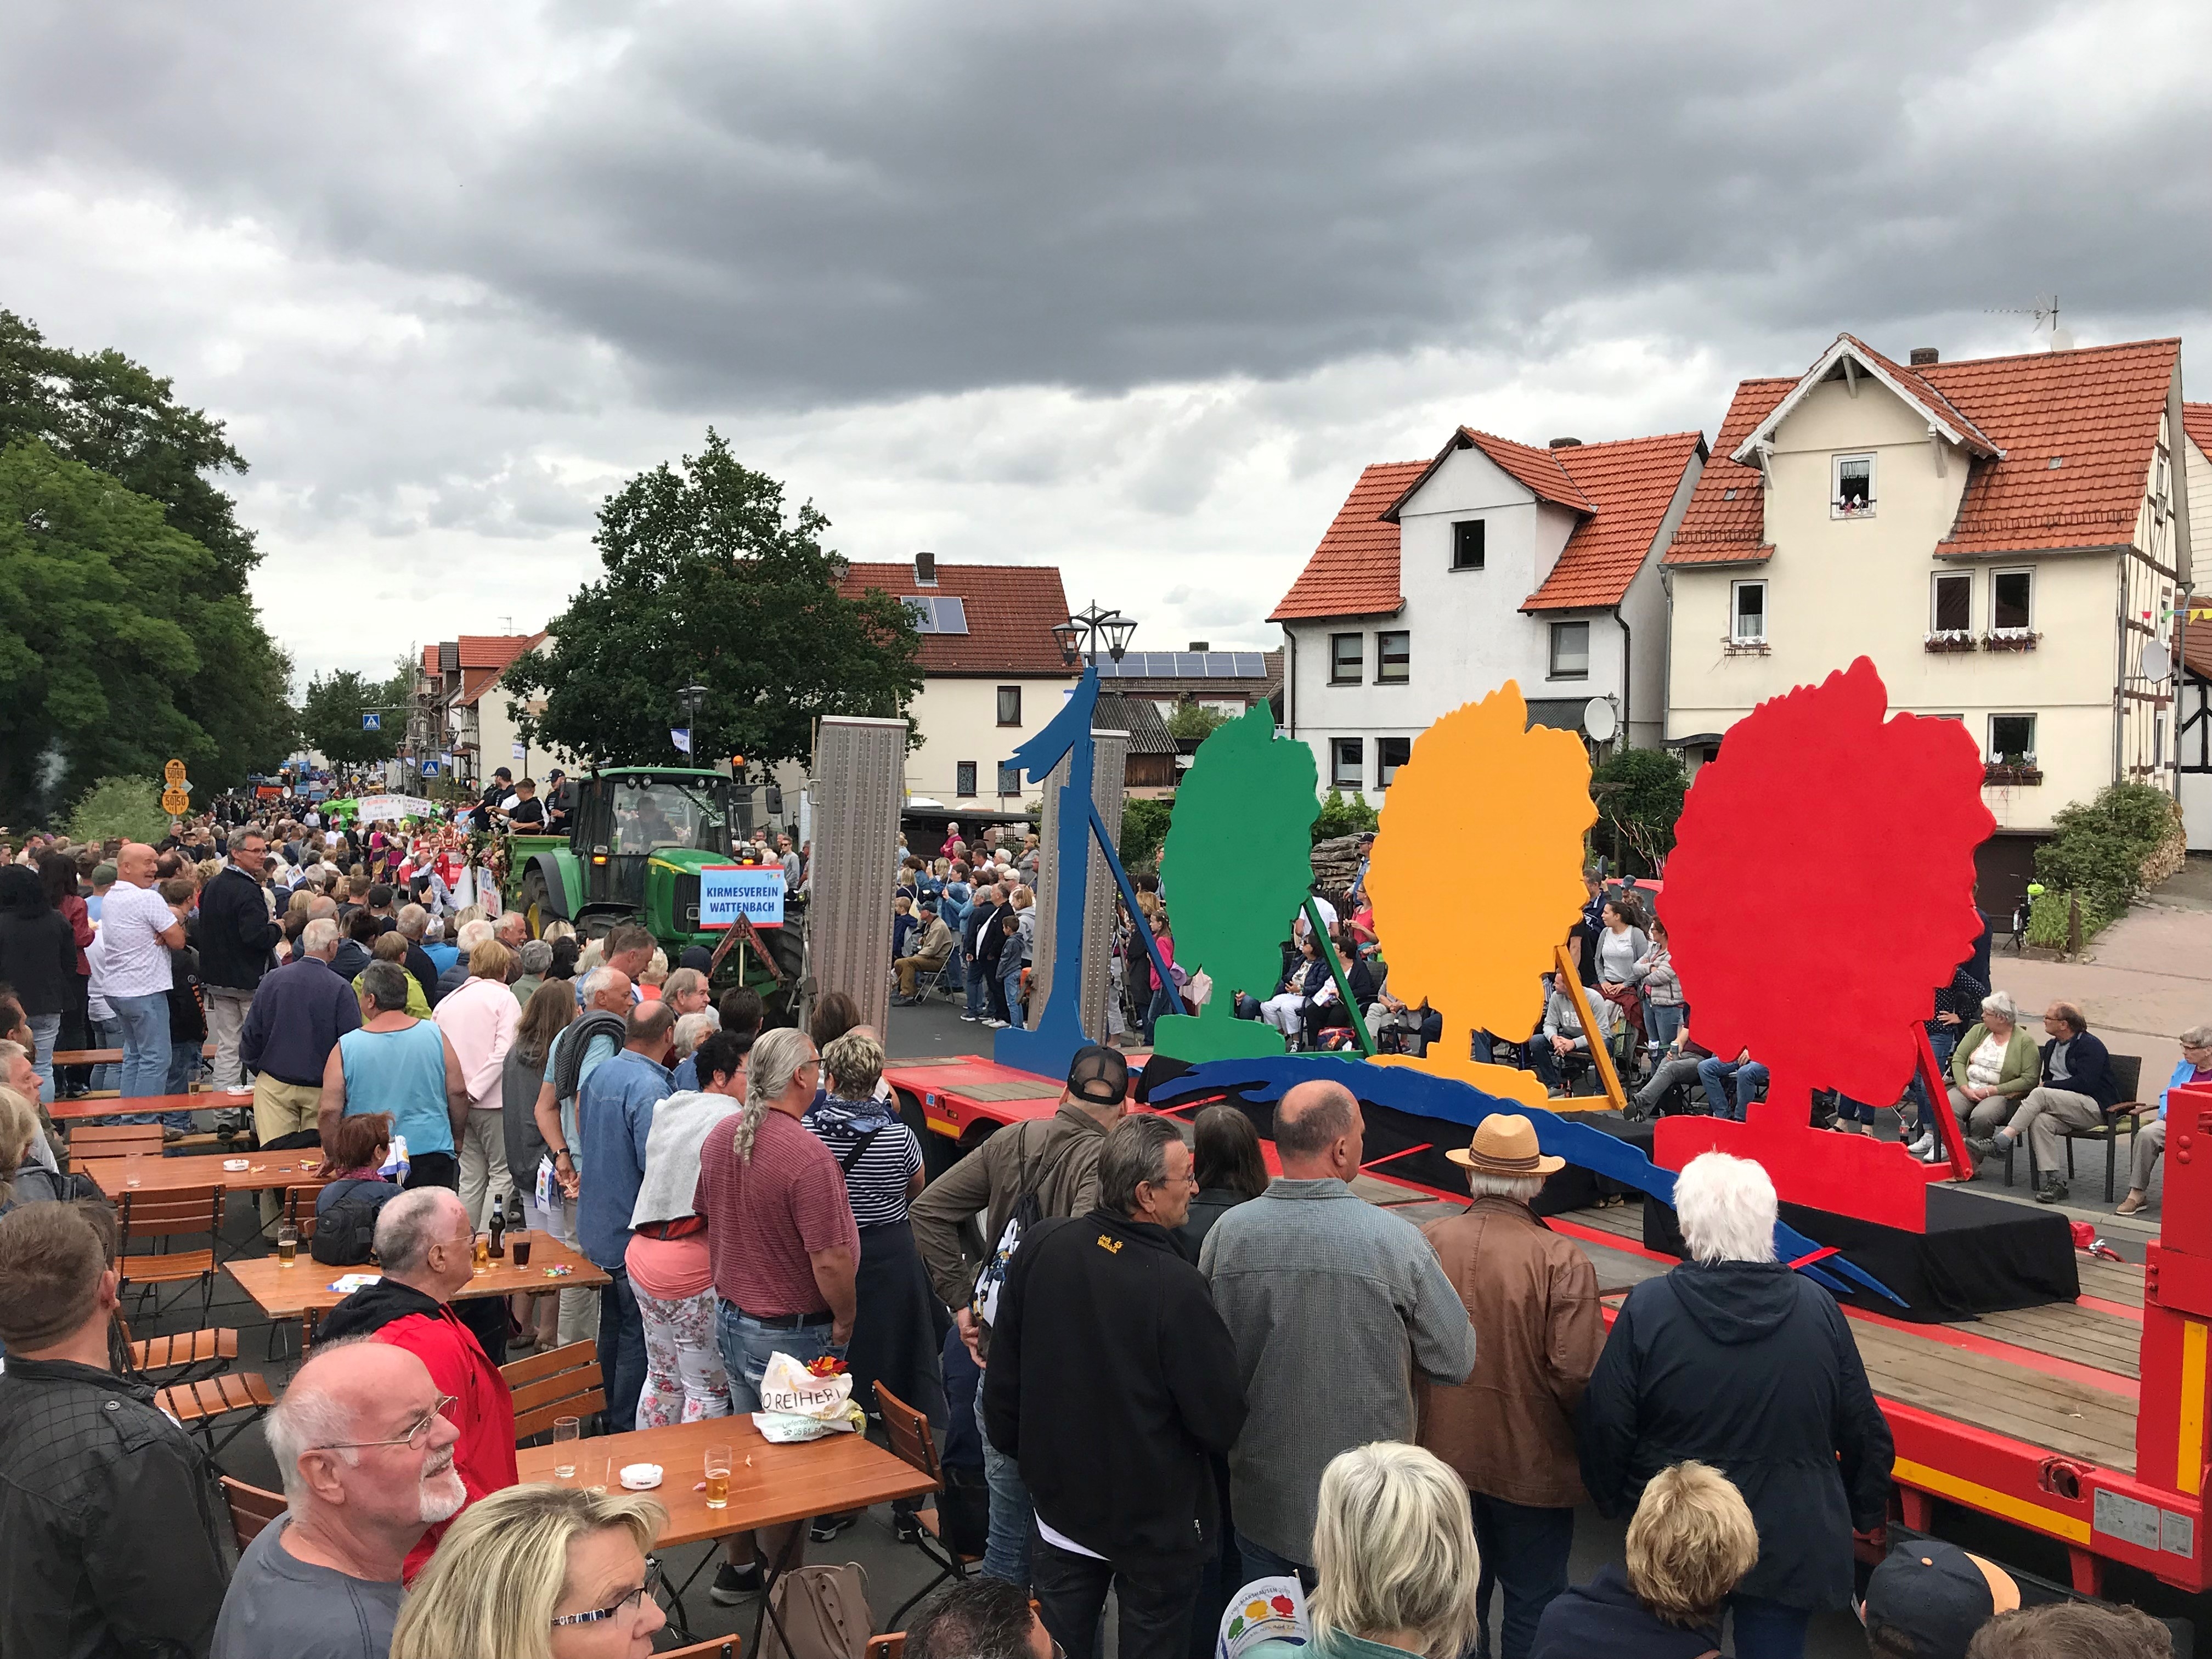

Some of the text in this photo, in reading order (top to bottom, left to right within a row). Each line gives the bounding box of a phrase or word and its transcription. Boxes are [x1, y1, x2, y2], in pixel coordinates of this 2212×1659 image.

[168, 769, 183, 779] 50 90
[166, 797, 185, 806] 50 50
[707, 887, 778, 897] KIRMESVEREIN
[710, 902, 775, 912] WATTENBACH
